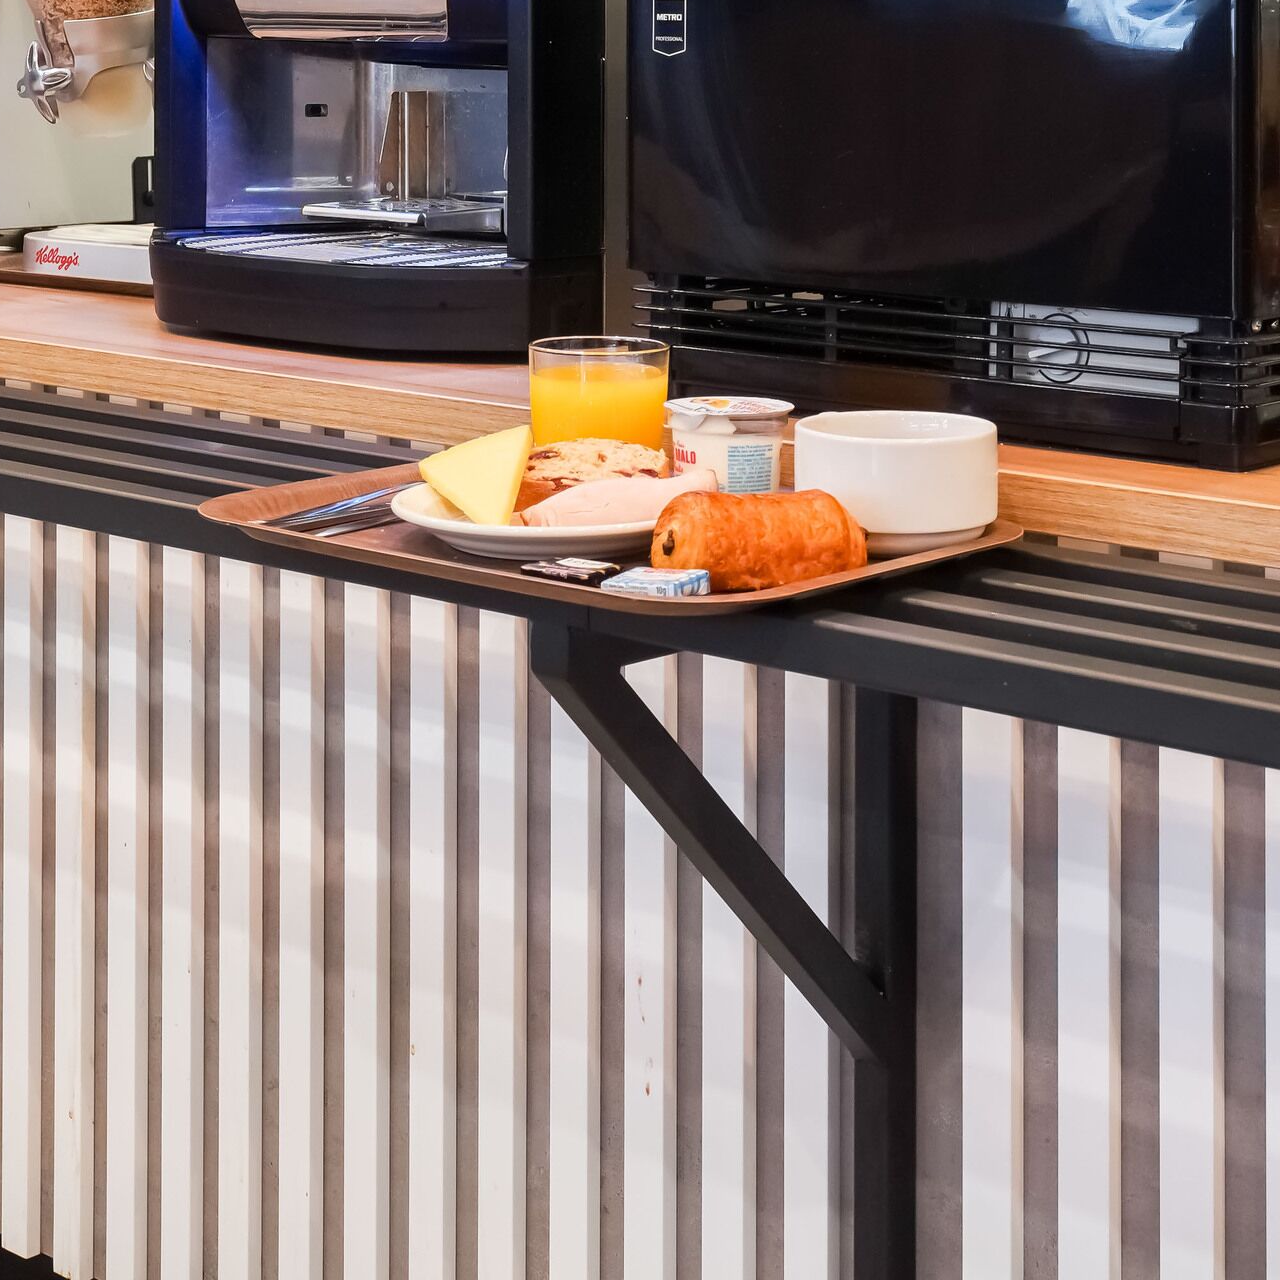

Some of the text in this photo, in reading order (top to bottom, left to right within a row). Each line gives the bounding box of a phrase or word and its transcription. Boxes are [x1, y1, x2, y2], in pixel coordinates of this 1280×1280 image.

[656, 13, 682, 21] METRO
[35, 245, 80, 270] Kellogg's
[674, 447, 697, 464] MALO
